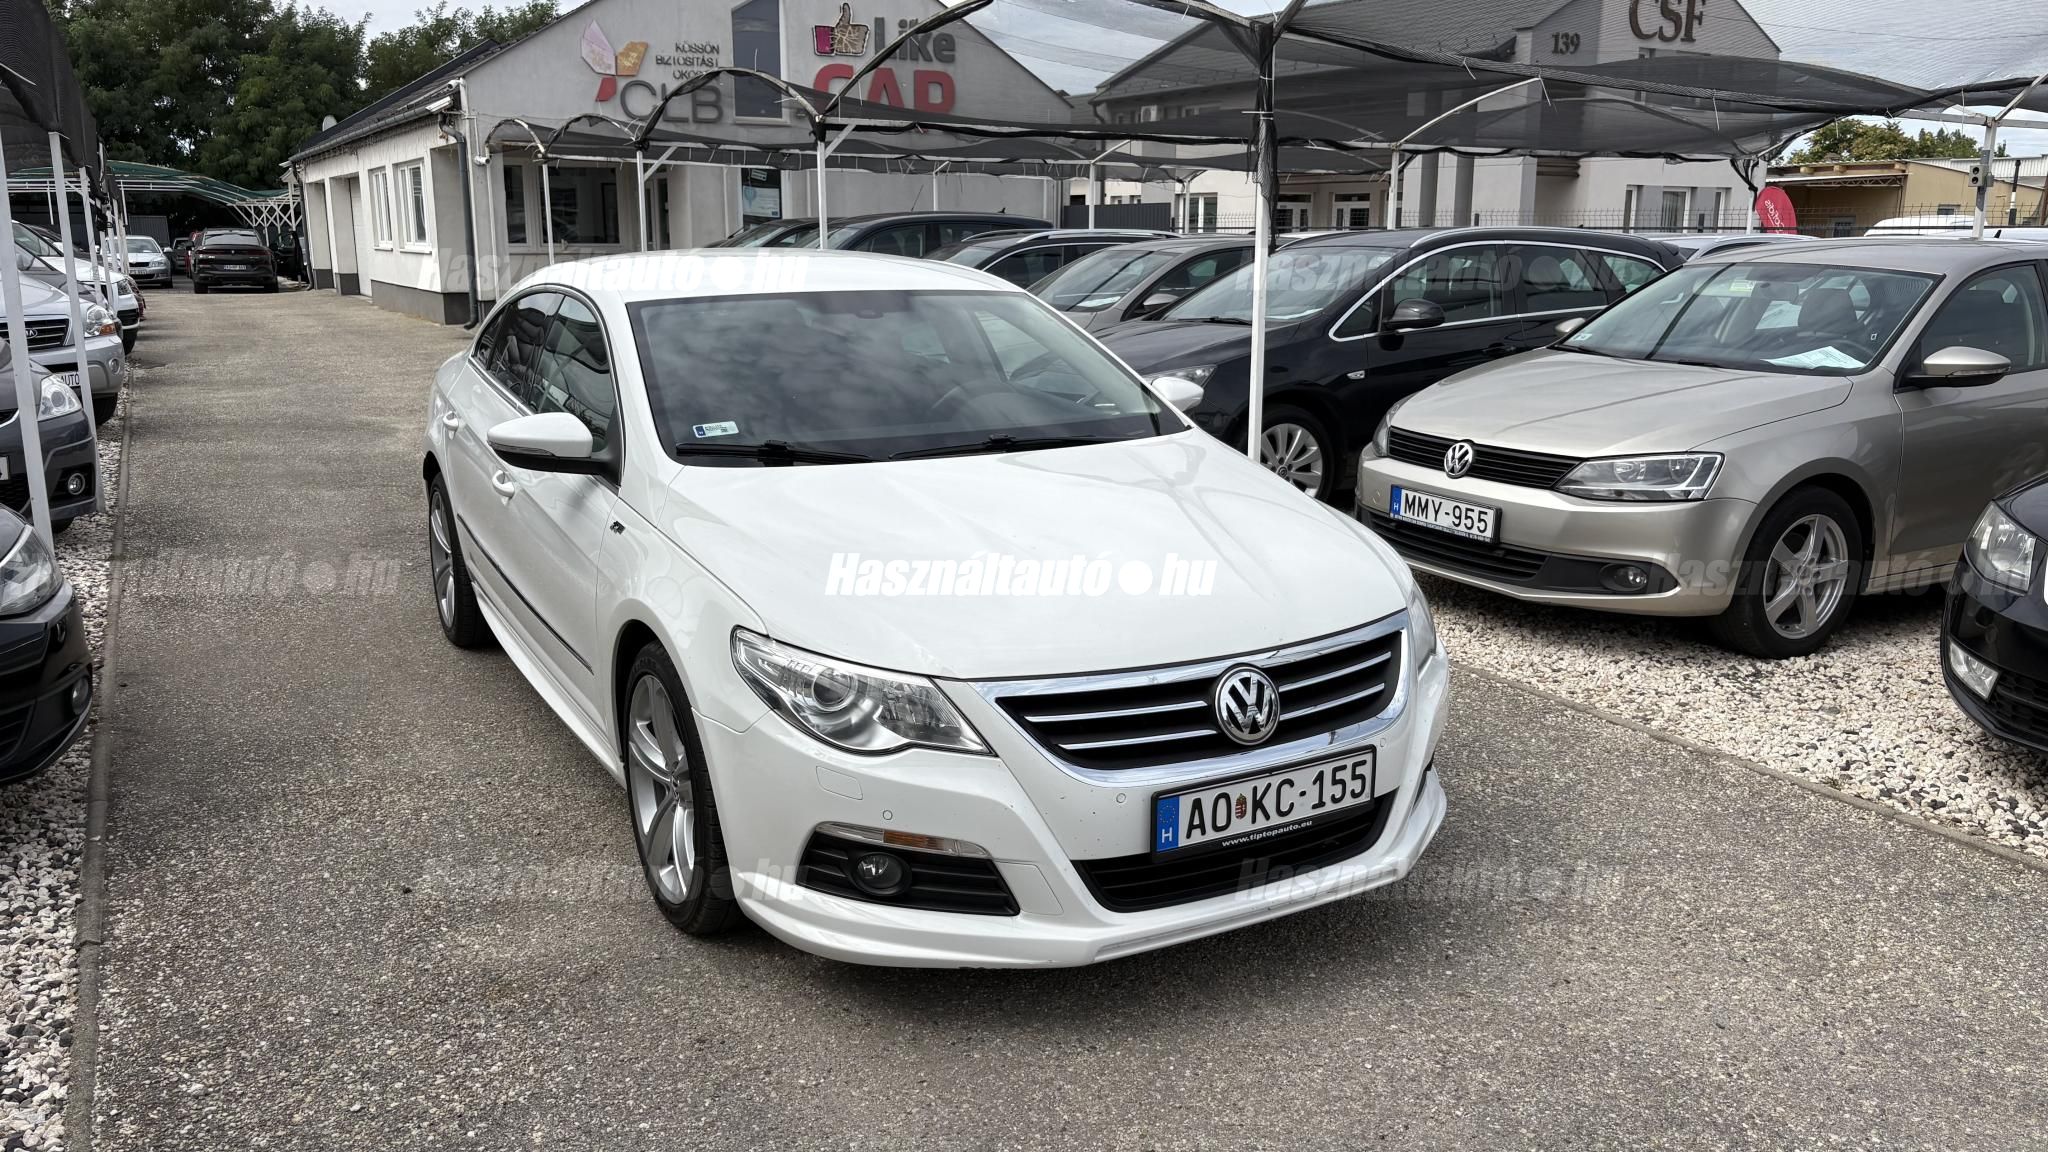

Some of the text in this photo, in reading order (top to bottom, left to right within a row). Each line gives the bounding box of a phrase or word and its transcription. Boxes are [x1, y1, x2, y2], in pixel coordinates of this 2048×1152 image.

[874, 17, 956, 63] Like
[1629, 0, 1704, 42] CSF
[1551, 32, 1581, 55] 139
[620, 80, 724, 123] CLB
[1404, 493, 1488, 534] MMY-955
[1161, 759, 1367, 843] H AO KC-155
[1221, 820, 1313, 847] www.tiptopauto.eu
